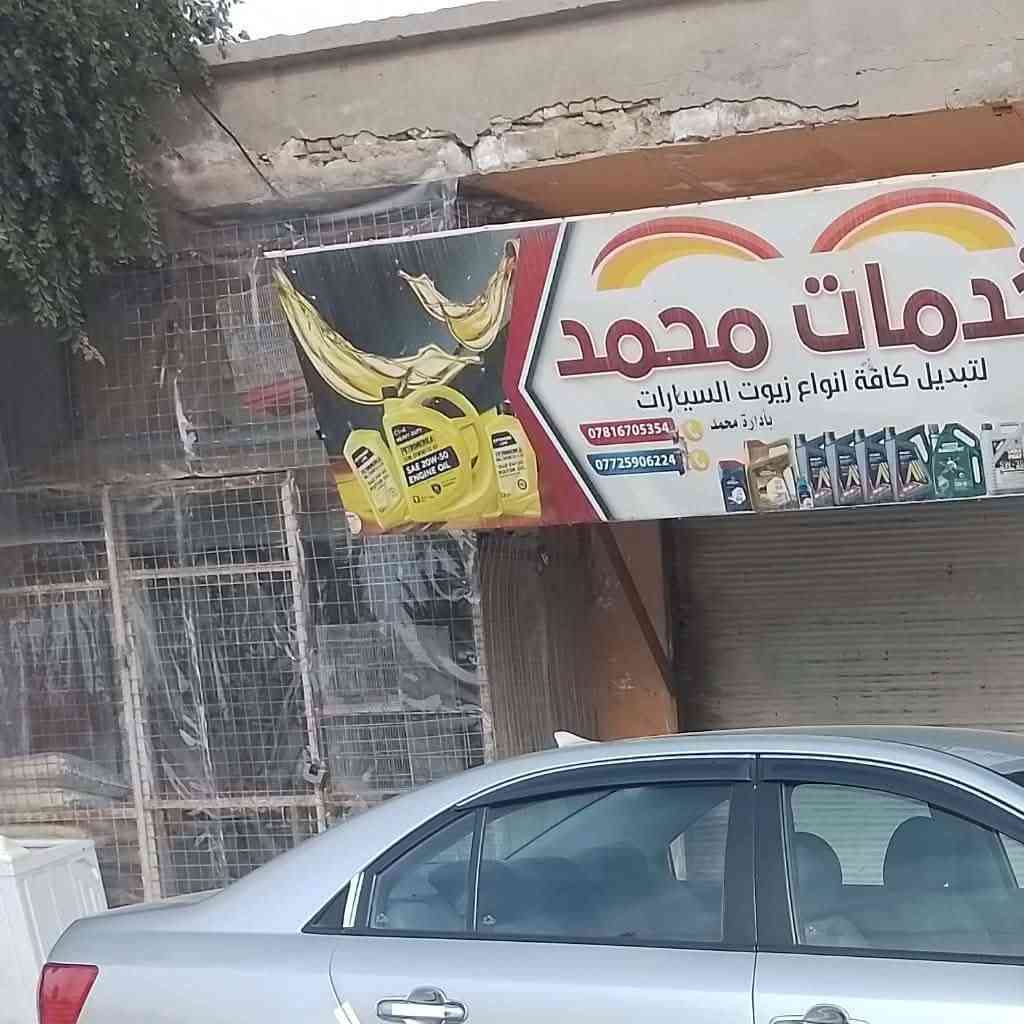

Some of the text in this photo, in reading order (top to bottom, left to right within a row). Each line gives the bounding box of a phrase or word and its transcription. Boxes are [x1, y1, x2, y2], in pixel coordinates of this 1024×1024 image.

[556, 306, 770, 379] محمد
[637, 357, 988, 412] لتبديل كافة انواع زيوت السيارات
[588, 421, 670, 439] 07816705354
[710, 417, 738, 430] محمد
[405, 462, 420, 474] SAE
[595, 454, 676, 471] 07725906224
[408, 461, 452, 484] ENGINE OIL
